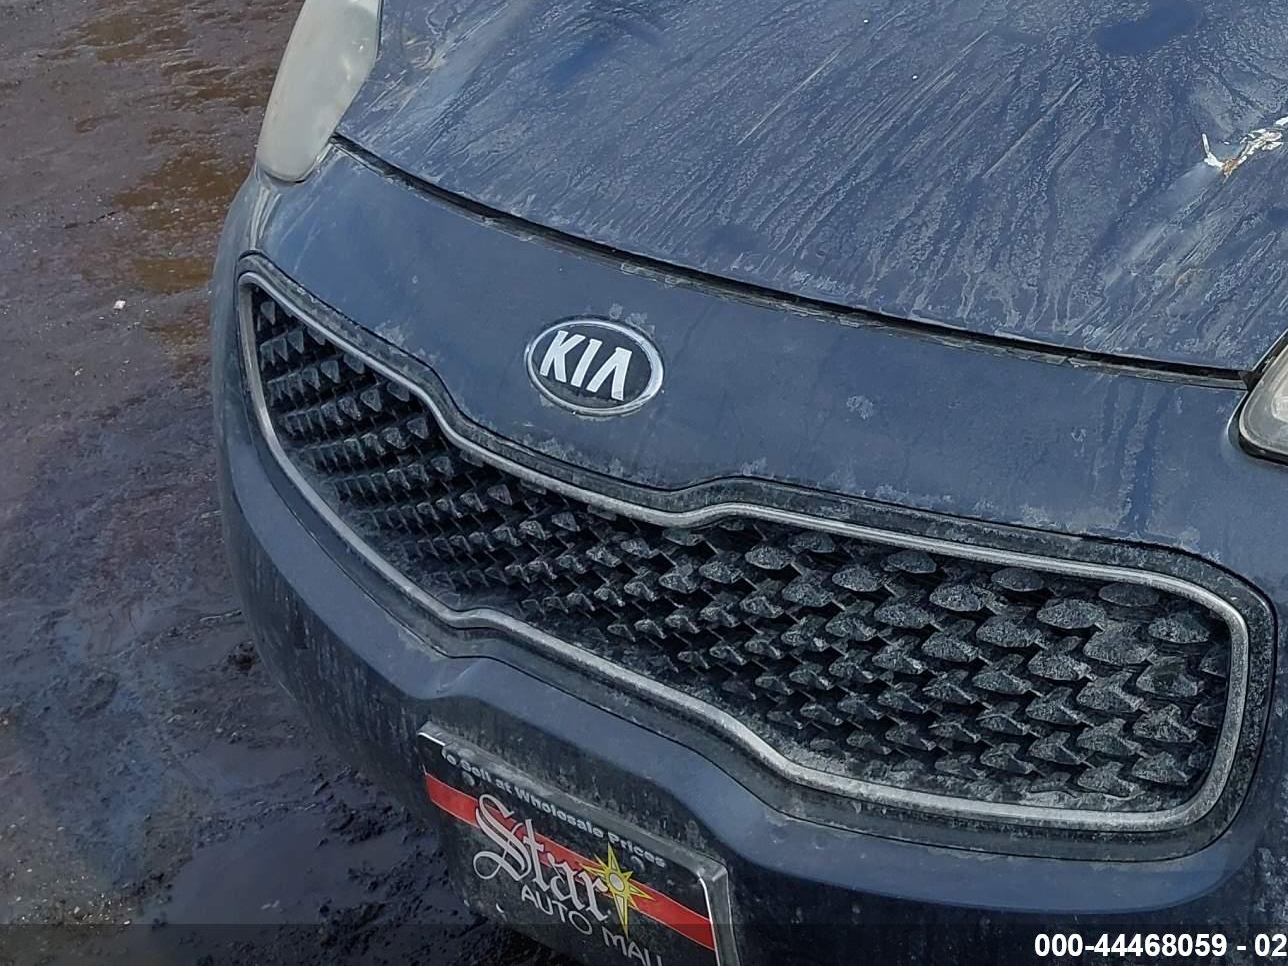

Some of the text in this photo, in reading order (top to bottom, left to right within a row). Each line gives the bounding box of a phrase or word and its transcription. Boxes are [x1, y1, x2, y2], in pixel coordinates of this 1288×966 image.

[539, 329, 633, 401] KIA
[460, 759, 493, 782] Sell
[496, 776, 514, 795] at
[514, 785, 604, 839] Wholesale
[607, 831, 666, 868] Prices
[473, 793, 610, 922] Star
[521, 884, 593, 935] AUTO
